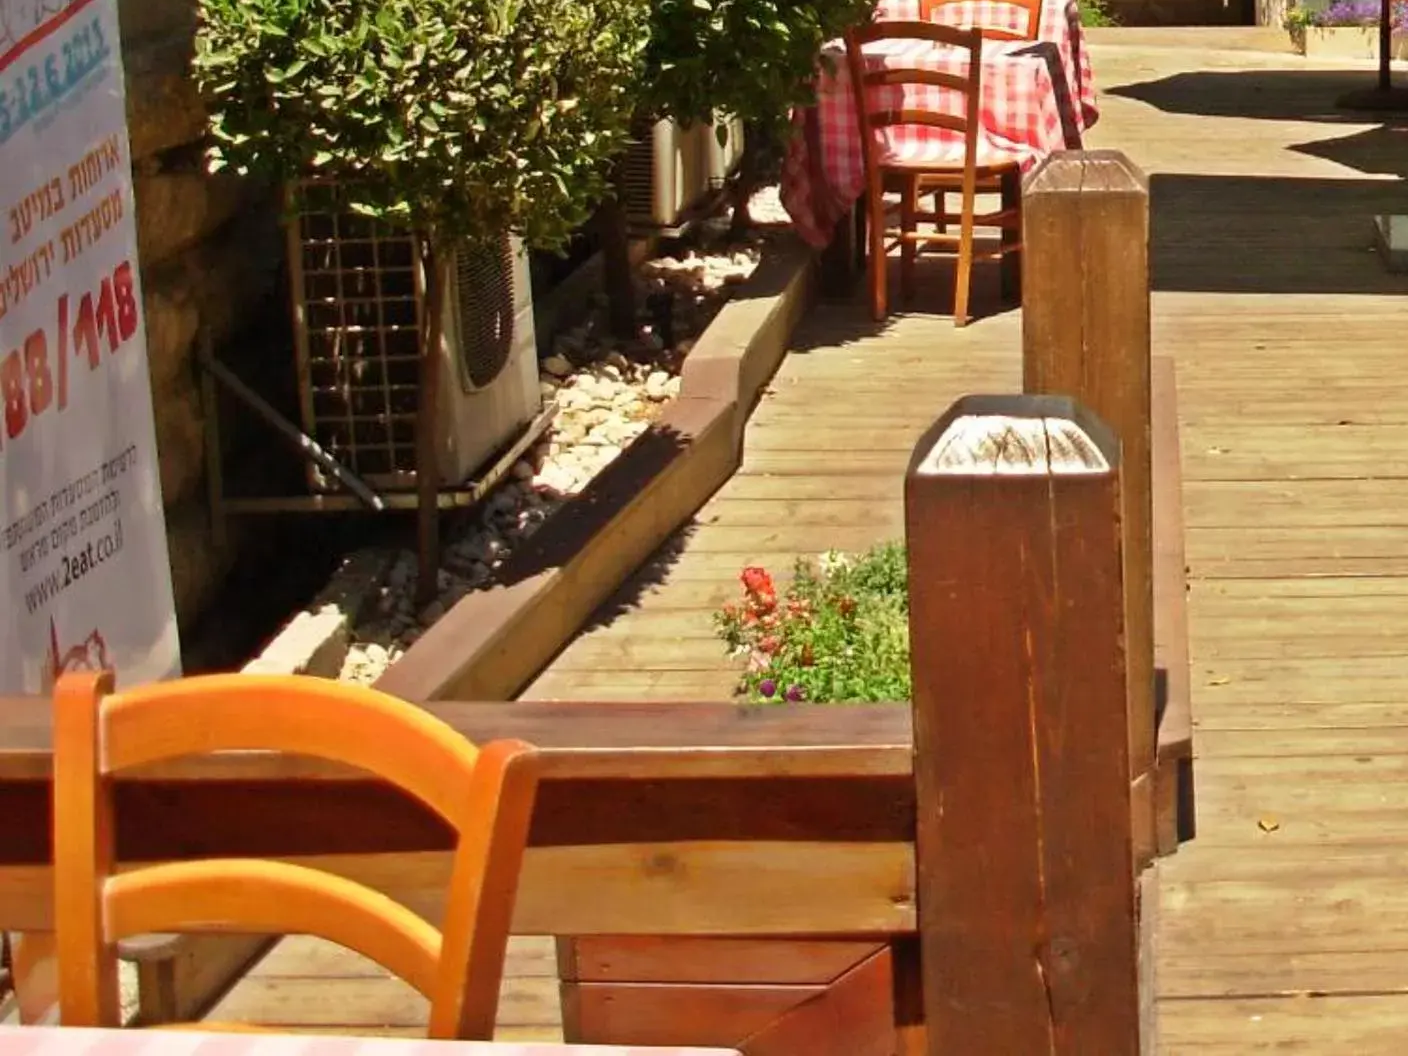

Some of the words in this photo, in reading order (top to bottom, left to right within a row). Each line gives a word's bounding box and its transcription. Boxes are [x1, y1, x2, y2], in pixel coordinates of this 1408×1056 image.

[68, 133, 120, 201] ארוחות
[10, 176, 66, 244] במיטב
[60, 186, 123, 264] מסעדות
[24, 517, 124, 615] www.2eat.co.il
